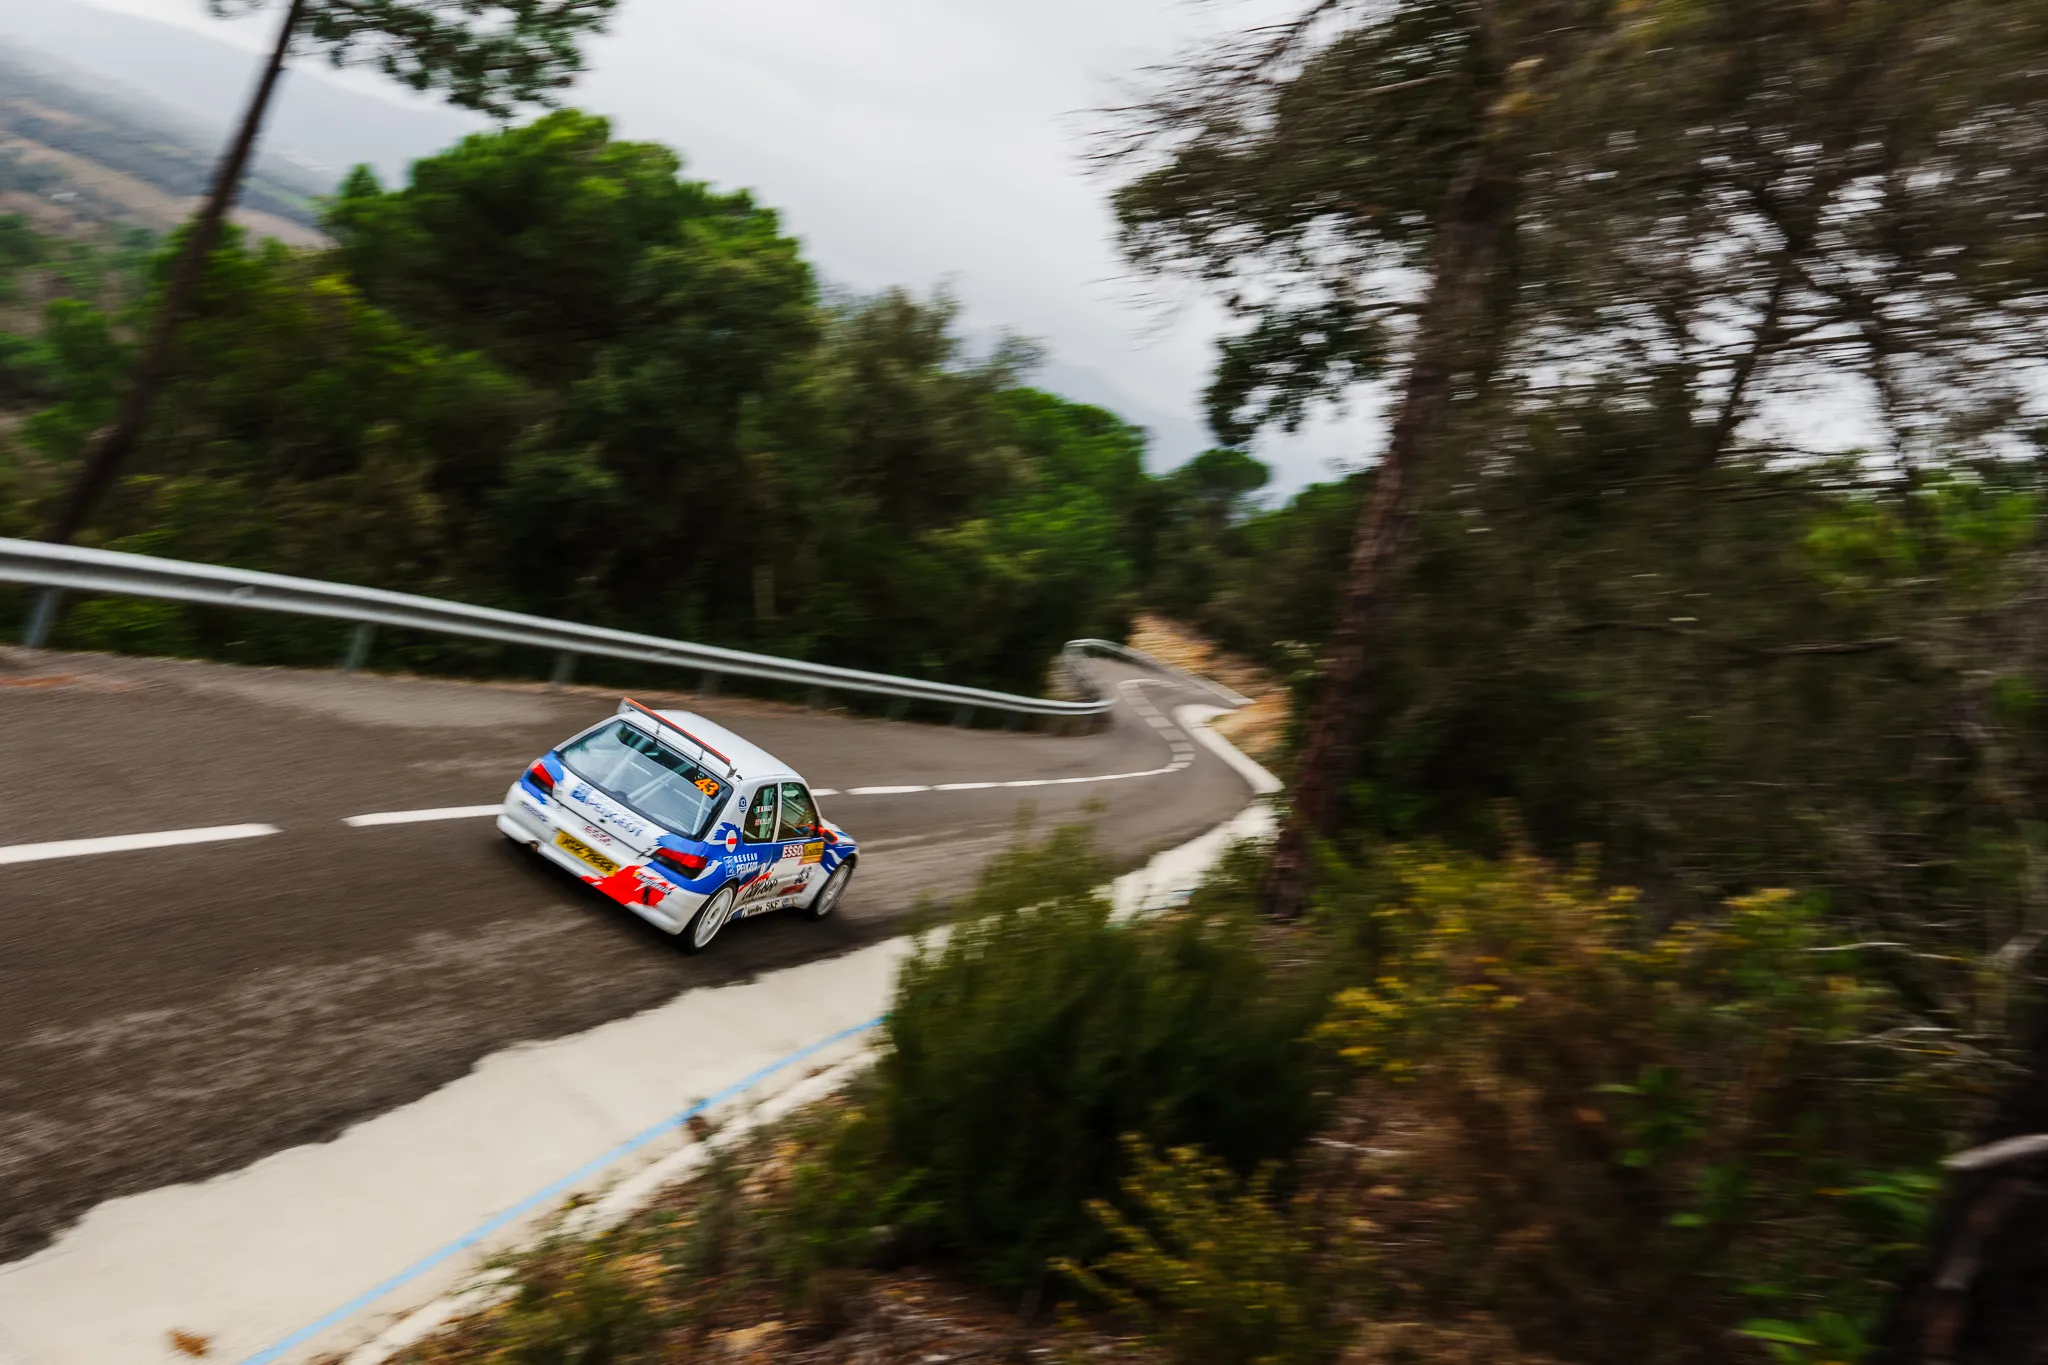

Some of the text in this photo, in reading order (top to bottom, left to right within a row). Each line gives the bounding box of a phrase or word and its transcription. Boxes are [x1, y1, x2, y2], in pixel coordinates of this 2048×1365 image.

[694, 778, 719, 796] 43
[782, 844, 804, 858] ESSO
[734, 853, 758, 864] RESEAU
[765, 899, 780, 912] SKF
